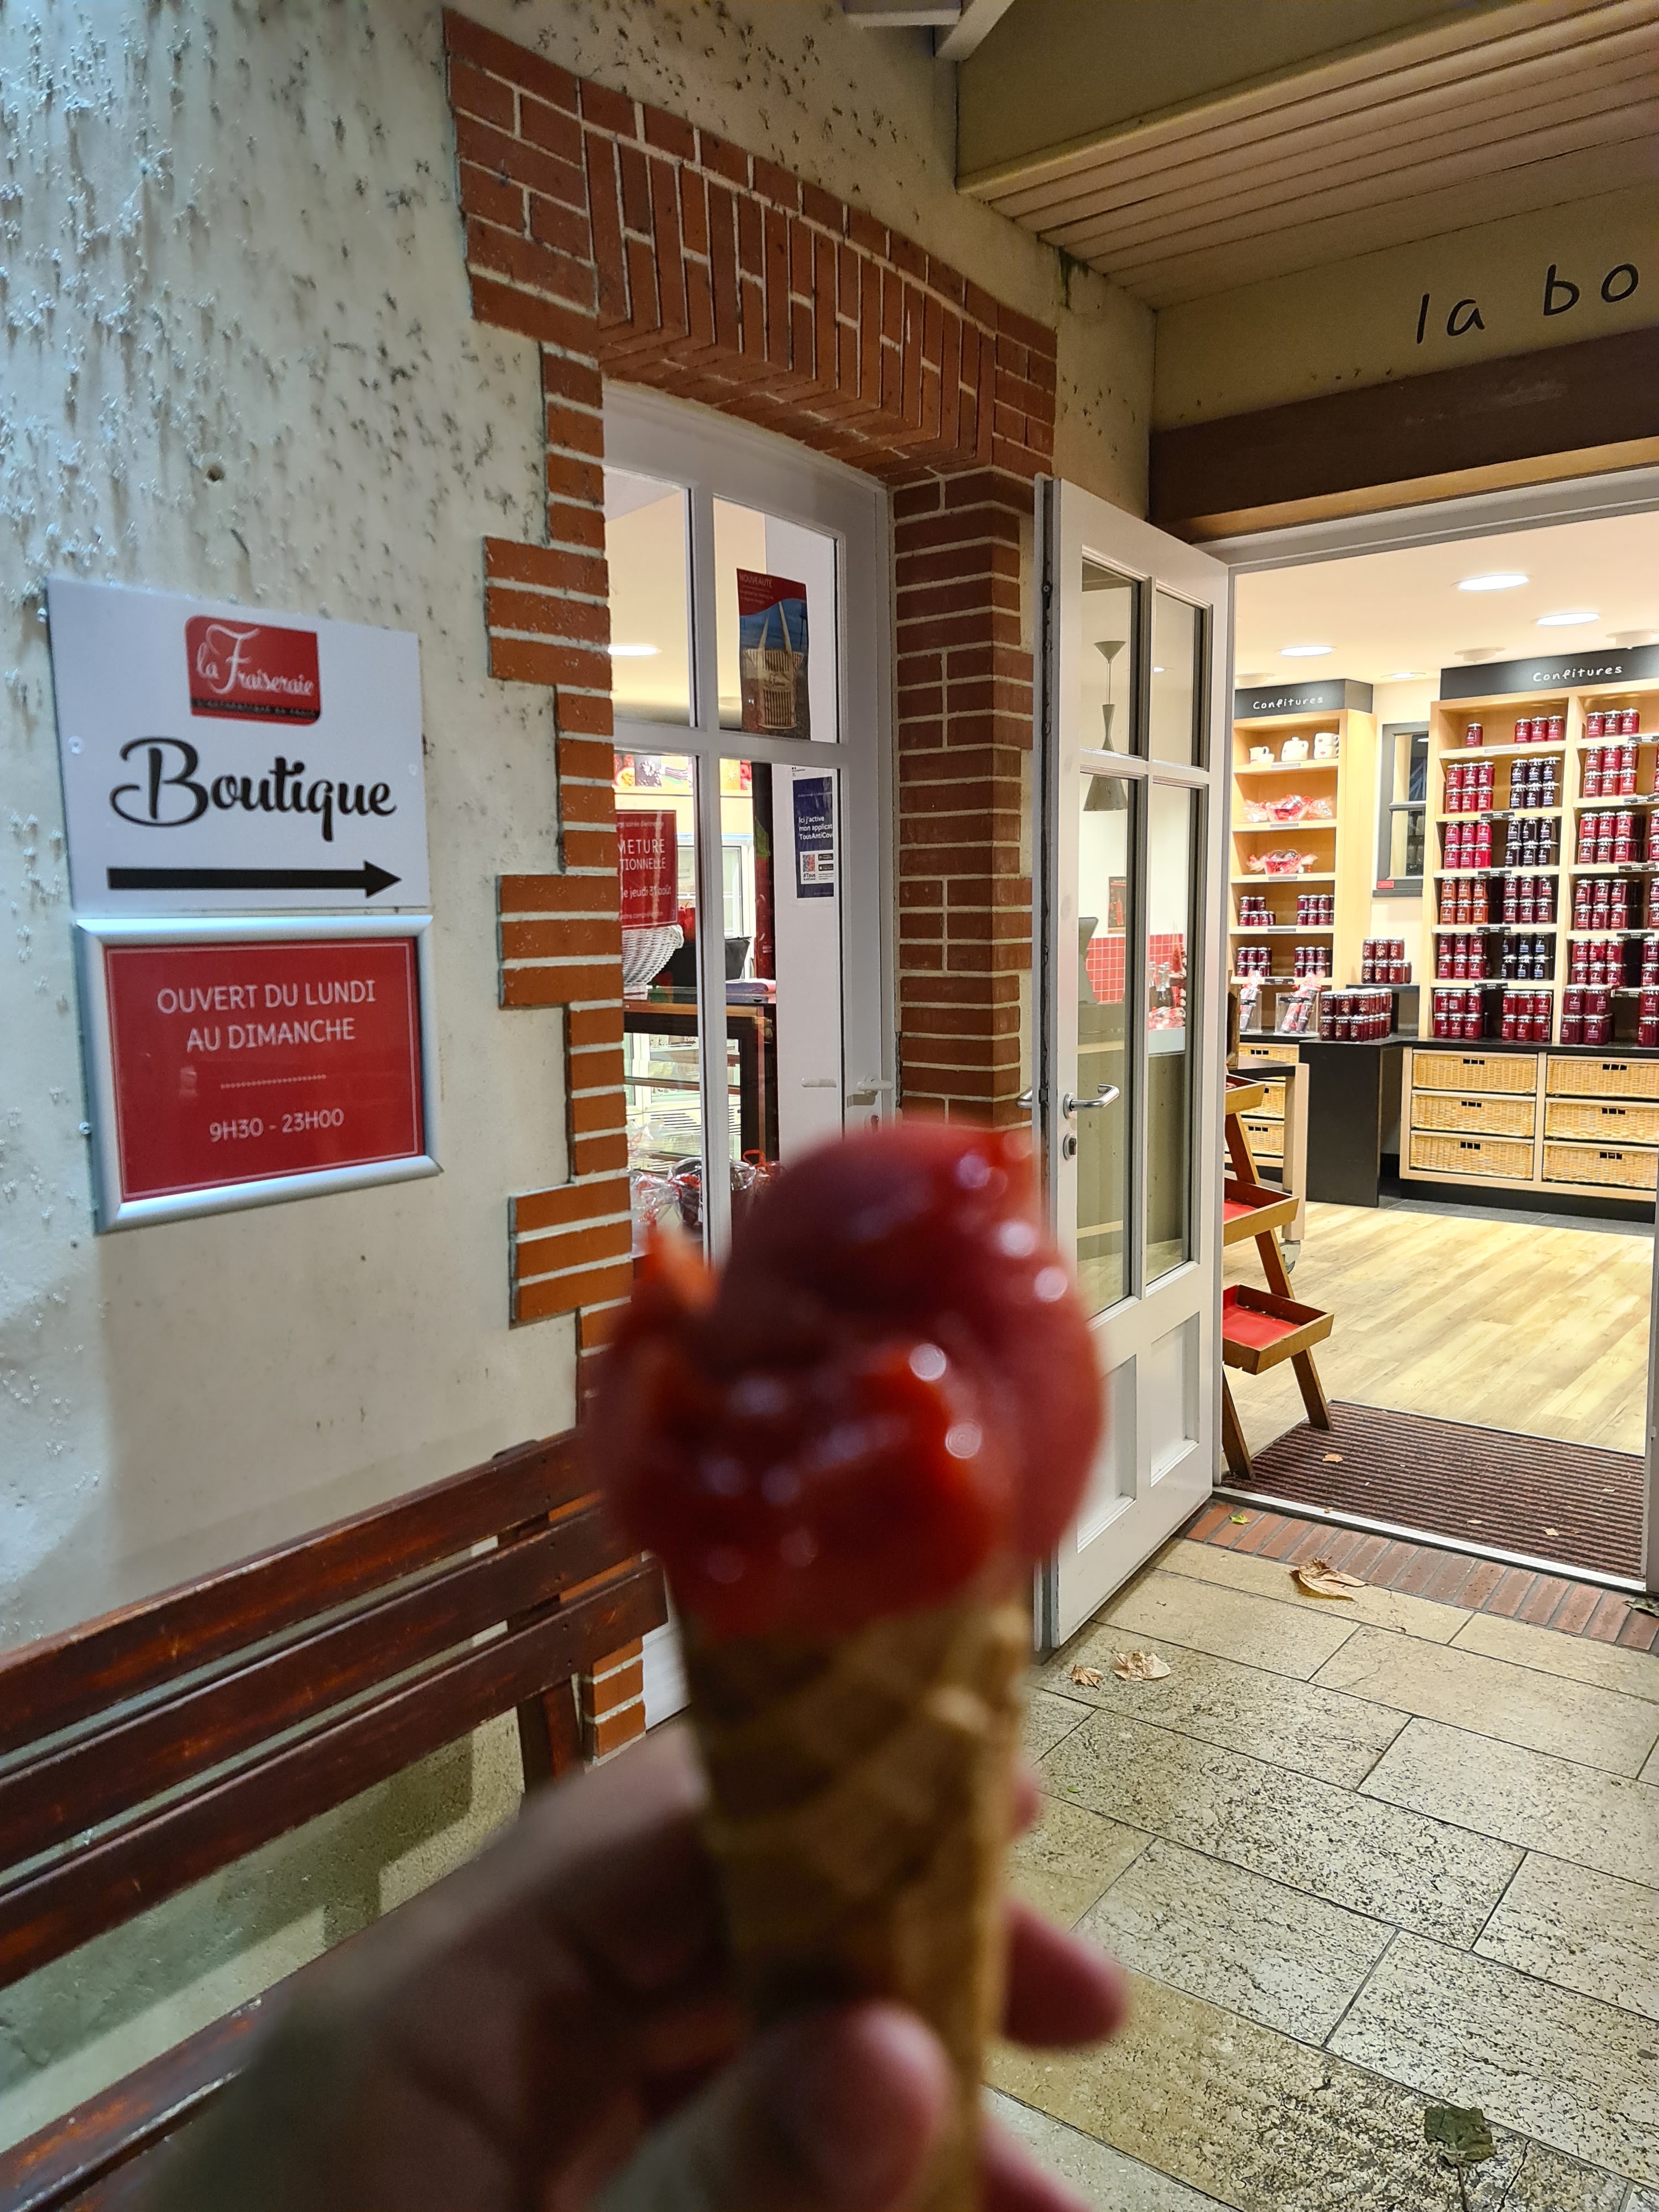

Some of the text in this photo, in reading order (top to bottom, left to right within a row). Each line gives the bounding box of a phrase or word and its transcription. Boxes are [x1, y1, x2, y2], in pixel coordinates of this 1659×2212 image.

[1416, 263, 1639, 344] la bo
[206, 624, 314, 696] Fraiseraie
[1533, 666, 1623, 682] Confitures
[1253, 696, 1323, 709] Confitures
[110, 736, 397, 842] Boutique
[805, 816, 825, 824] j'active
[630, 886, 648, 899] jeudi
[156, 979, 376, 1014] OUVERT DU LUNDI
[186, 1018, 355, 1052] AU DIMANCHE
[210, 1119, 262, 1142] 9H30
[282, 1109, 345, 1134] 23H00
